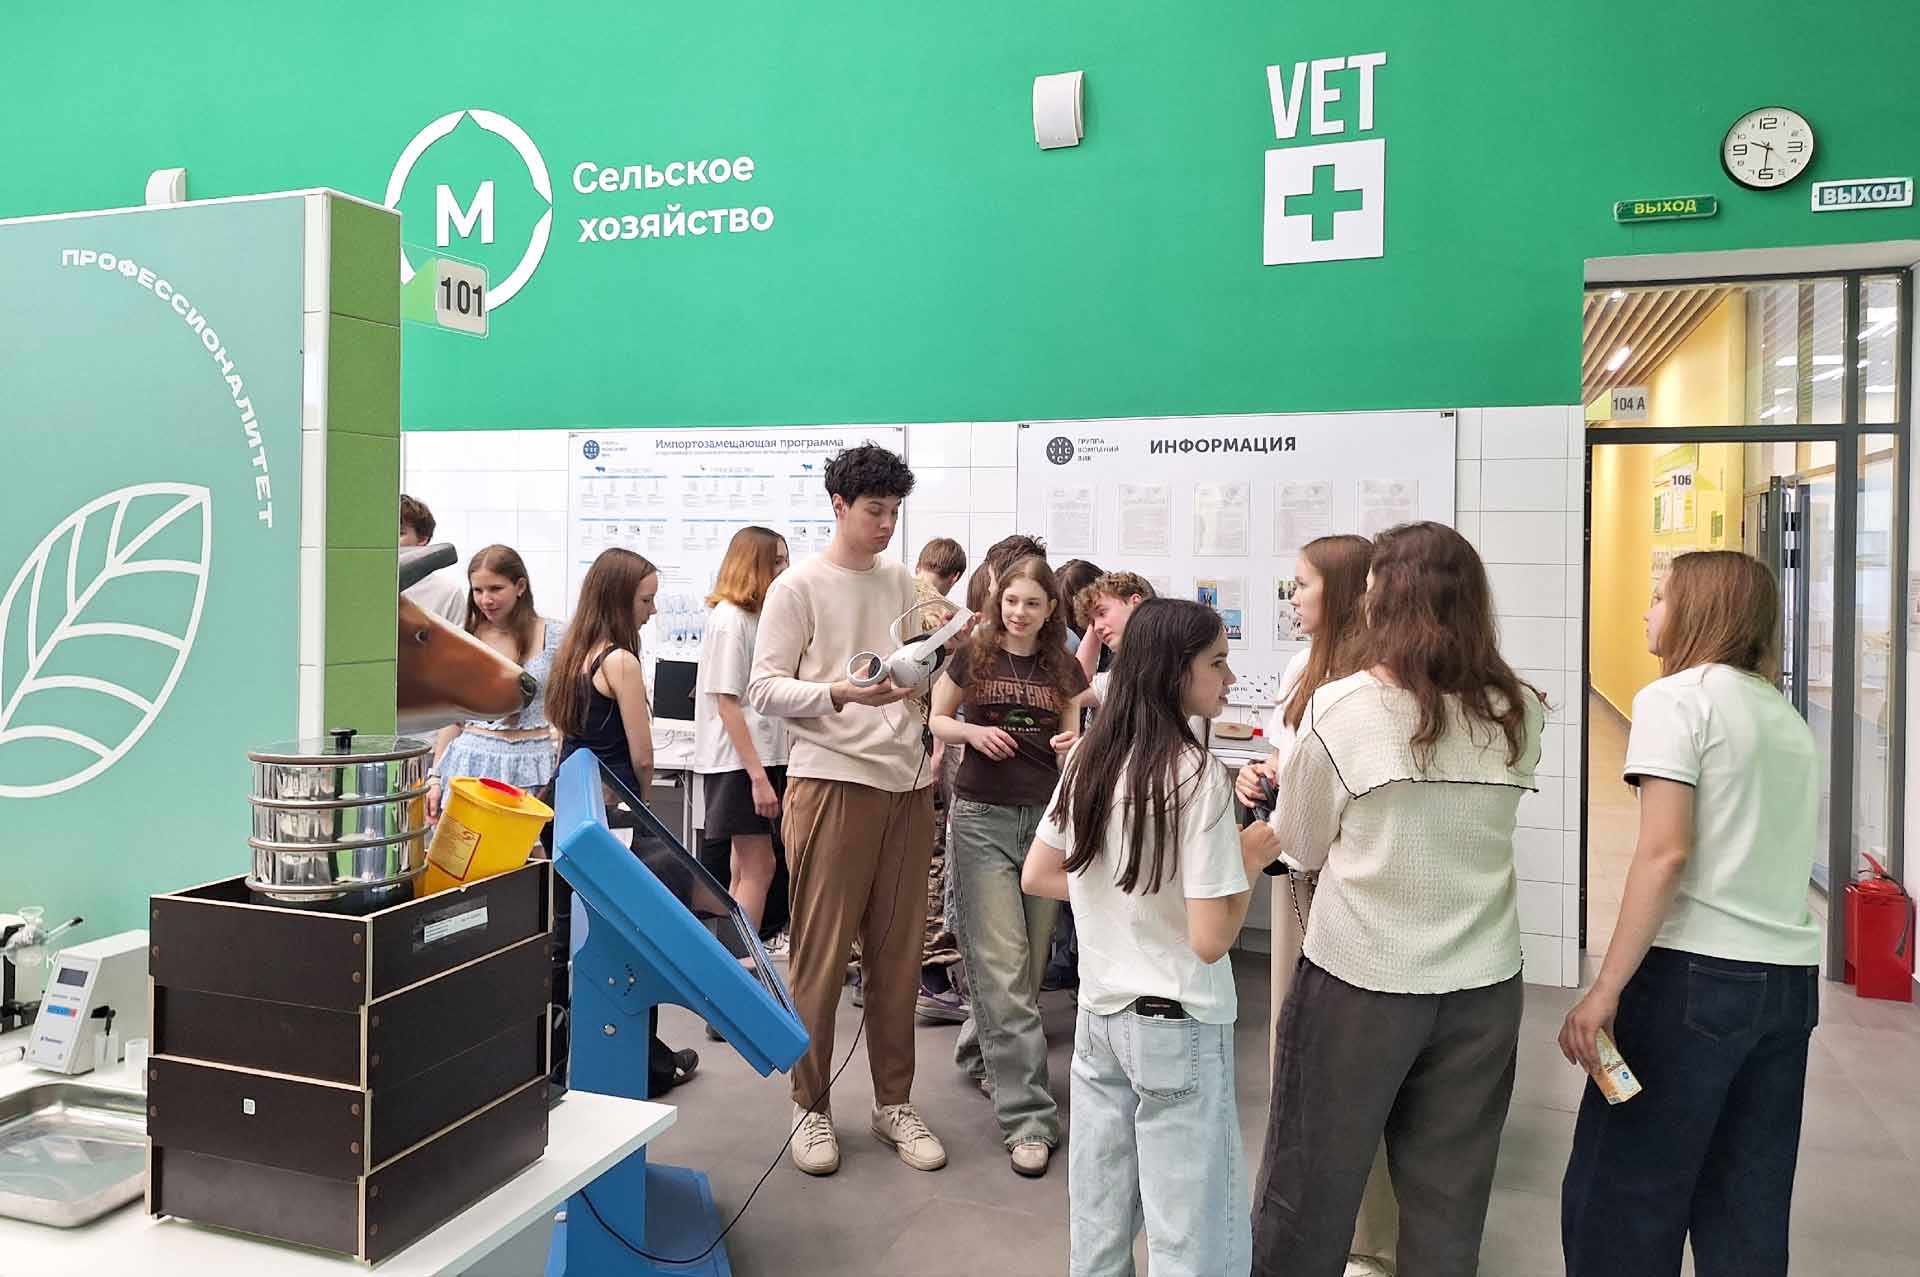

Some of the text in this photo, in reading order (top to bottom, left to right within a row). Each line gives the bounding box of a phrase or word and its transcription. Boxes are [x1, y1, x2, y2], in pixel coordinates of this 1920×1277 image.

[1265, 52, 1387, 140] VET
[1760, 117, 1778, 130] 12
[1732, 144, 1748, 156] 9
[1787, 140, 1804, 153] 3
[572, 155, 755, 194] Сельское
[1758, 167, 1774, 180] 6
[1822, 184, 1904, 205] ВЫХОД
[435, 180, 495, 248] М
[1633, 199, 1698, 215] ВЫХОД
[577, 203, 775, 243] хозяйство
[440, 276, 484, 318] 101
[61, 249, 273, 528] ПРОФЕССИОНАЛИТЕТ
[1613, 397, 1634, 411] 104
[655, 437, 845, 450] Импортозамещающая программа
[1150, 436, 1297, 455] ИНФОРМАЦИЯ
[1671, 474, 1693, 486] 106
